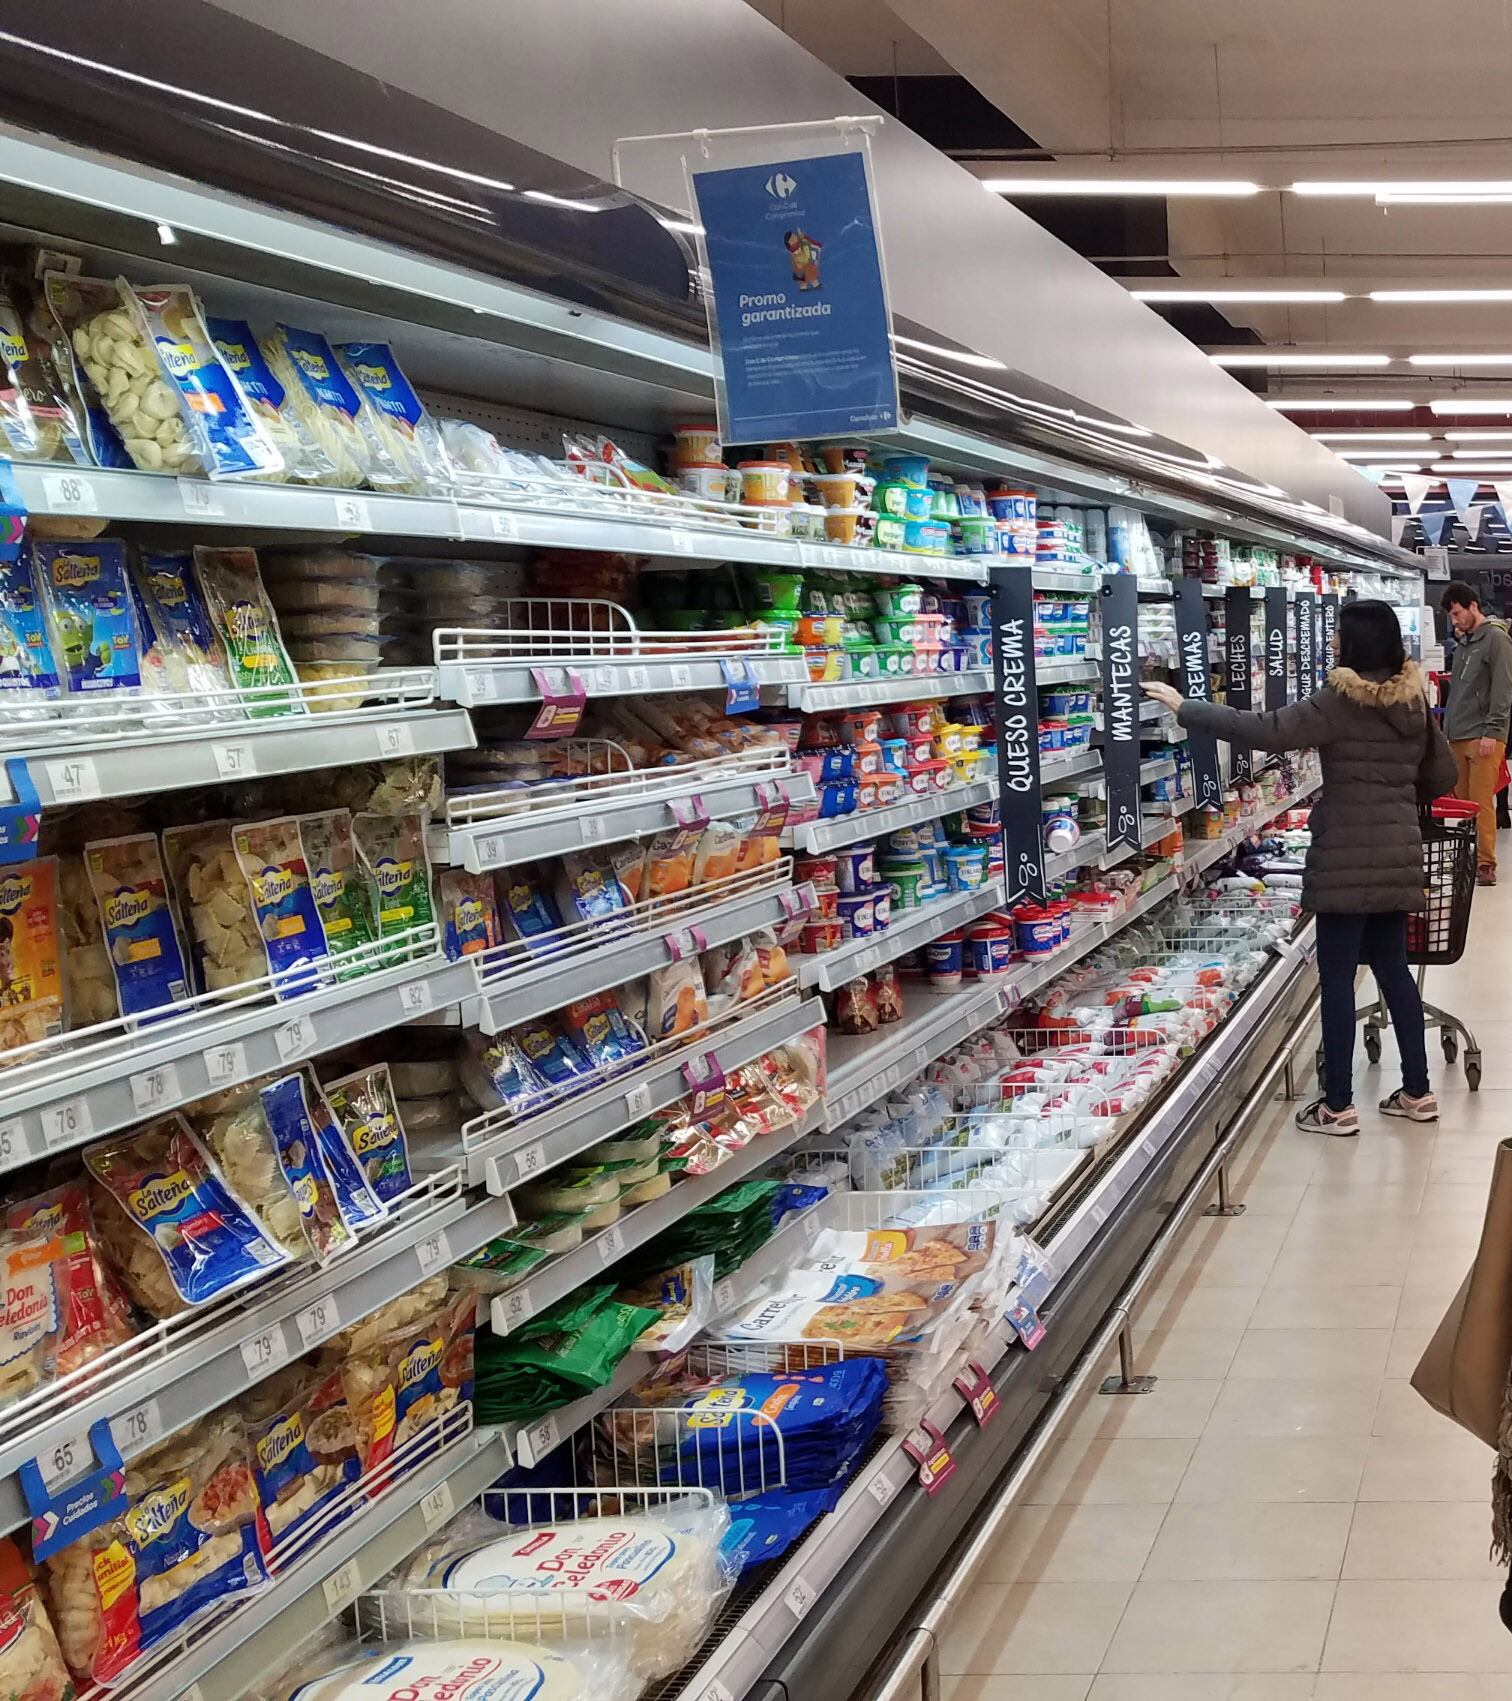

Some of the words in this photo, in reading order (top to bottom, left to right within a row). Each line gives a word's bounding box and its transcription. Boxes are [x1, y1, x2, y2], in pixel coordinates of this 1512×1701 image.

[740, 292, 786, 309] Promo
[742, 302, 832, 327] garantizada
[1300, 599, 1311, 670] DESCREMADO
[1000, 618, 1028, 708] CREMA
[1229, 634, 1246, 692] LECHES
[1269, 628, 1285, 677] SALUD
[1183, 631, 1206, 702] REMAS
[1111, 624, 1133, 741] MANTECAS
[1301, 672, 1312, 702] OGUR
[1006, 713, 1033, 792] QUESO
[64, 765, 80, 786] 47
[378, 867, 411, 892] alteña
[108, 897, 148, 924] Salteña
[147, 1074, 163, 1098] 78
[136, 1179, 189, 1217] Salteña
[141, 1188, 151, 1198] La
[6, 1284, 34, 1303] Don
[311, 1307, 326, 1329] 79
[255, 1336, 271, 1356] 79
[127, 1412, 147, 1438] 78
[54, 1443, 74, 1471] 65
[261, 1423, 301, 1465] Salteña
[63, 1500, 98, 1526] Cuidados
[536, 1547, 583, 1573] Don
[387, 1674, 442, 1701] Don
